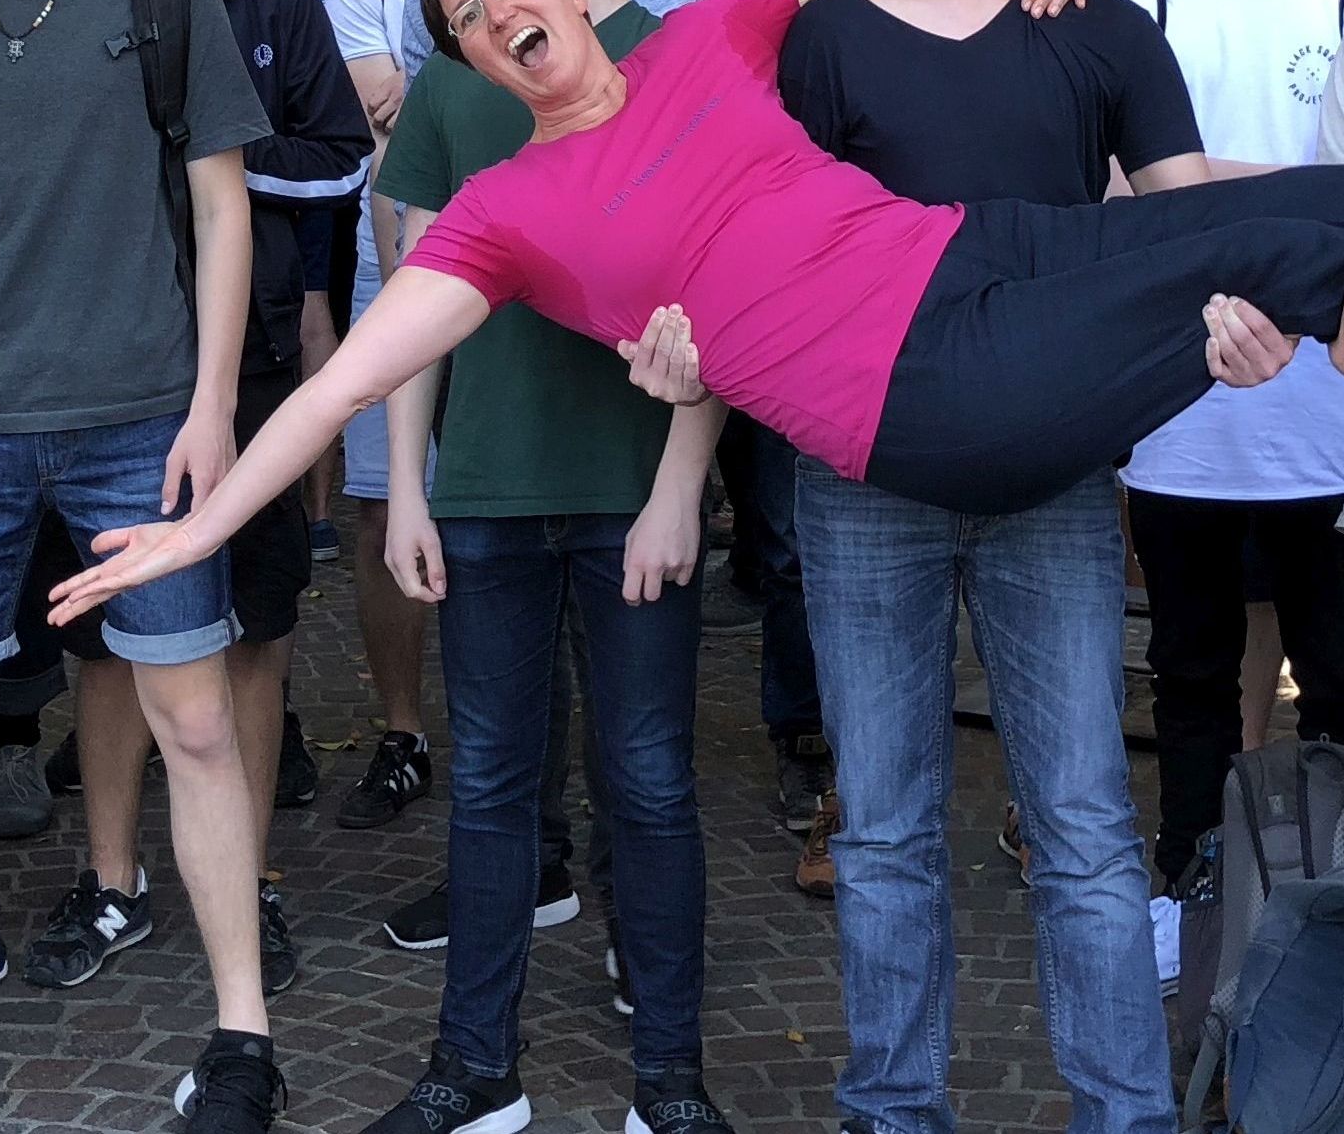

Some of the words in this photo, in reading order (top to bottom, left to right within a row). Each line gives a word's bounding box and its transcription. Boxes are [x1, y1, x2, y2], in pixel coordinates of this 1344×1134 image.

[1286, 45, 1313, 74] BLACK
[411, 1082, 471, 1114] ppa
[648, 1099, 723, 1128] Kapp
